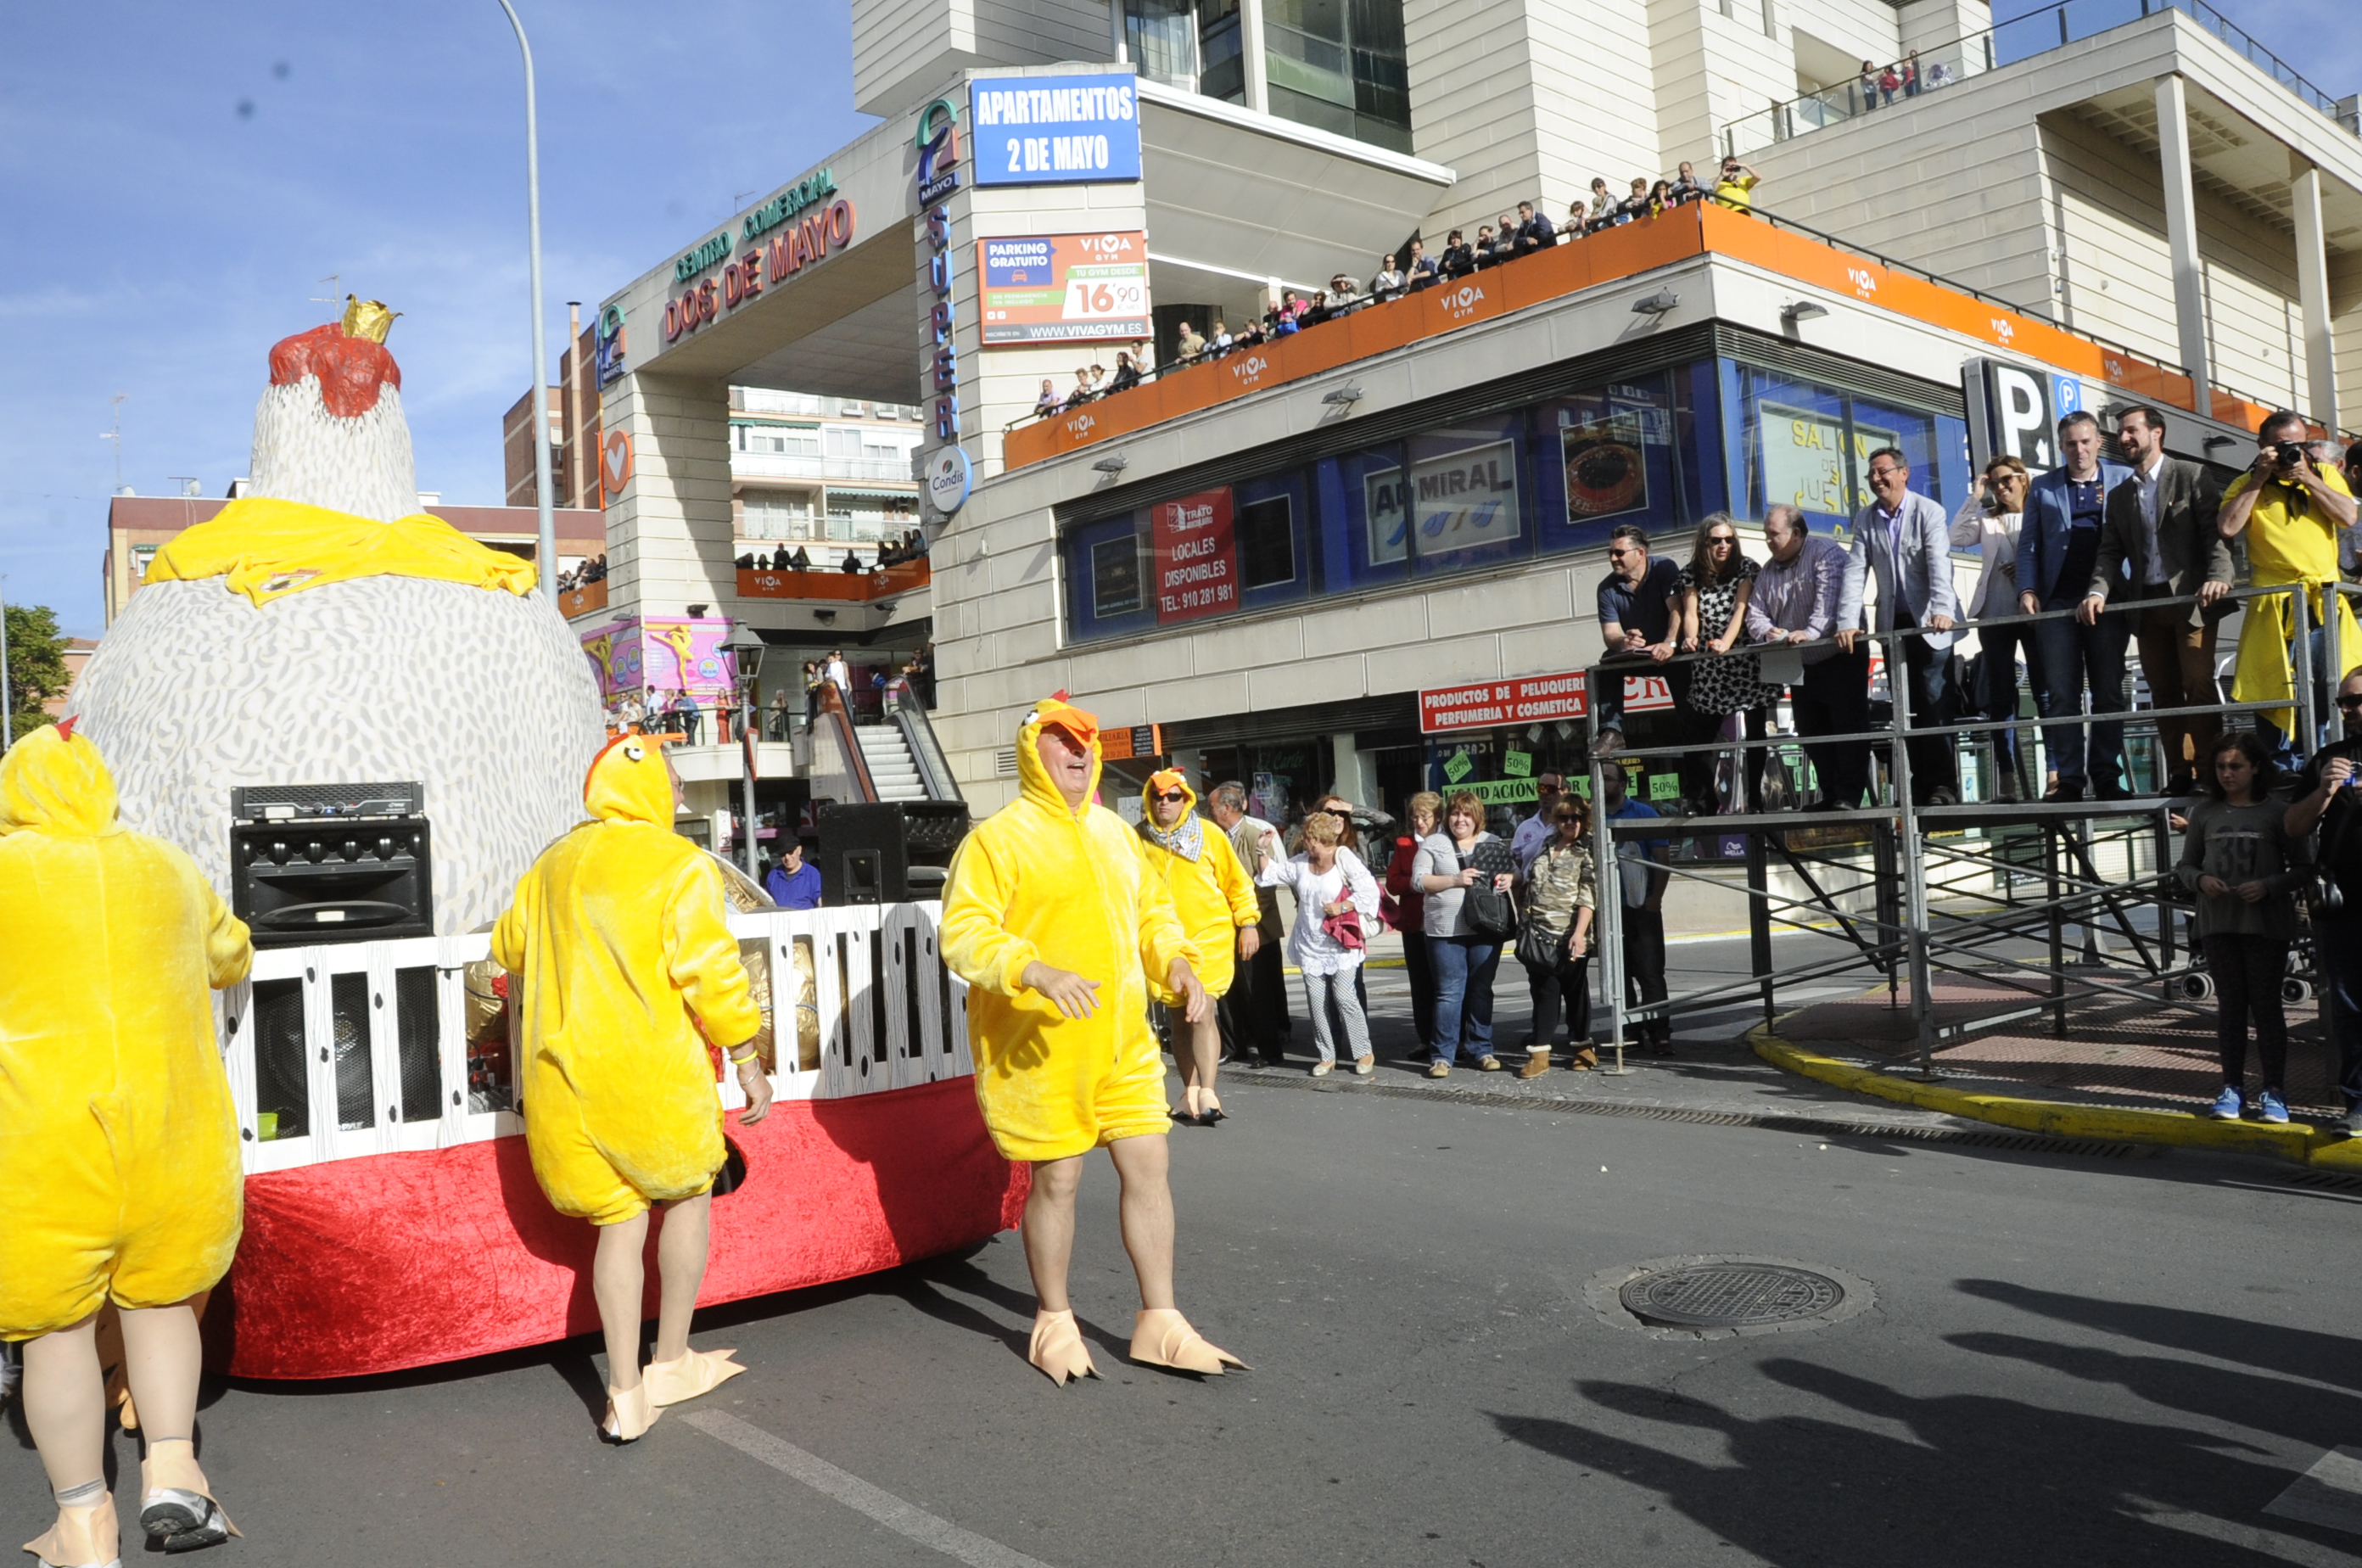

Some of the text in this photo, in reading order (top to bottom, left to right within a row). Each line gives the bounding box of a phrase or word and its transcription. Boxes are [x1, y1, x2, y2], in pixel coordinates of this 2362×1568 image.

[977, 86, 1133, 125] APARTAMENTOS
[1006, 134, 1109, 172] 2 DE MAYO
[921, 176, 952, 200] MAYO
[674, 167, 838, 283] CENTRO COMERCIAL
[989, 243, 1048, 256] PARKING
[1080, 234, 1132, 253] VIVA
[664, 199, 856, 342] DOS DE MAYO
[989, 255, 1048, 267] GRATUITO
[1089, 268, 1109, 277] GYM
[1848, 266, 1877, 292] VIVA
[1441, 285, 1485, 308] VIVA
[927, 206, 960, 439] SUPER
[1453, 306, 1475, 319] GYM
[1030, 322, 1142, 338] WWW.VIVAGYM.ES
[1990, 317, 2014, 338] VIVA
[1233, 356, 1268, 377] VIVA
[1243, 373, 1260, 385] GYM
[2063, 384, 2074, 408] P
[1067, 414, 1094, 434] VIVA
[1997, 367, 2044, 459] P
[932, 471, 964, 490] Condis
[1185, 506, 1213, 521] TRATO
[1172, 536, 1215, 562] LOCALES
[754, 575, 781, 587] VIVA
[1165, 559, 1226, 588] DISPONIBLES
[1161, 595, 1181, 613] TEL:
[1182, 591, 1198, 608] 910
[1200, 586, 1215, 605] 281
[1217, 583, 1233, 602] 981
[1425, 677, 1586, 709] PRODUCTOS DE PELUQUERI
[1435, 697, 1582, 726] PERFUMERIA Y COSMETICA
[1447, 758, 1469, 779] 50%
[1506, 758, 1530, 771] 50%
[1444, 780, 1536, 803] LIDACIÓN
[1652, 782, 1677, 794] 50%
